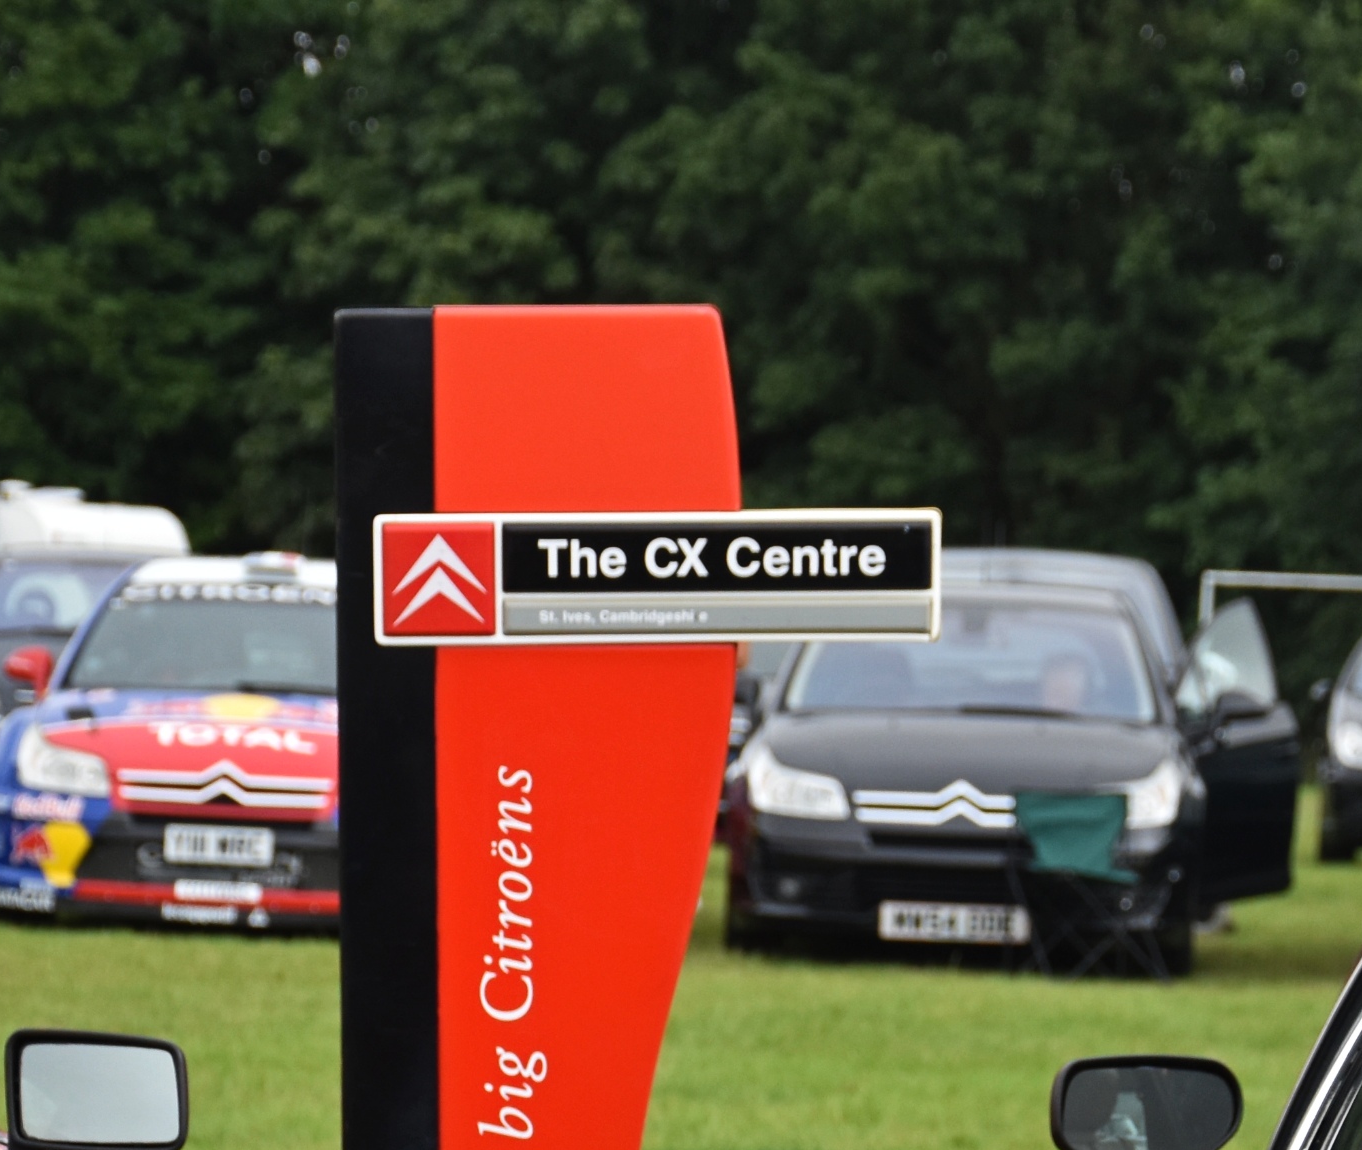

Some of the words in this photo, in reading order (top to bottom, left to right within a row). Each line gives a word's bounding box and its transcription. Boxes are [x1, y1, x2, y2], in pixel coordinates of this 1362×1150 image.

[537, 538, 627, 578] The
[644, 538, 709, 577] CX
[726, 536, 887, 578] Centre
[539, 609, 558, 625] St.
[563, 609, 596, 626] Ives,
[148, 721, 317, 756] TOTAL
[479, 765, 533, 1021] Citroëns
[477, 1046, 548, 1141] big
